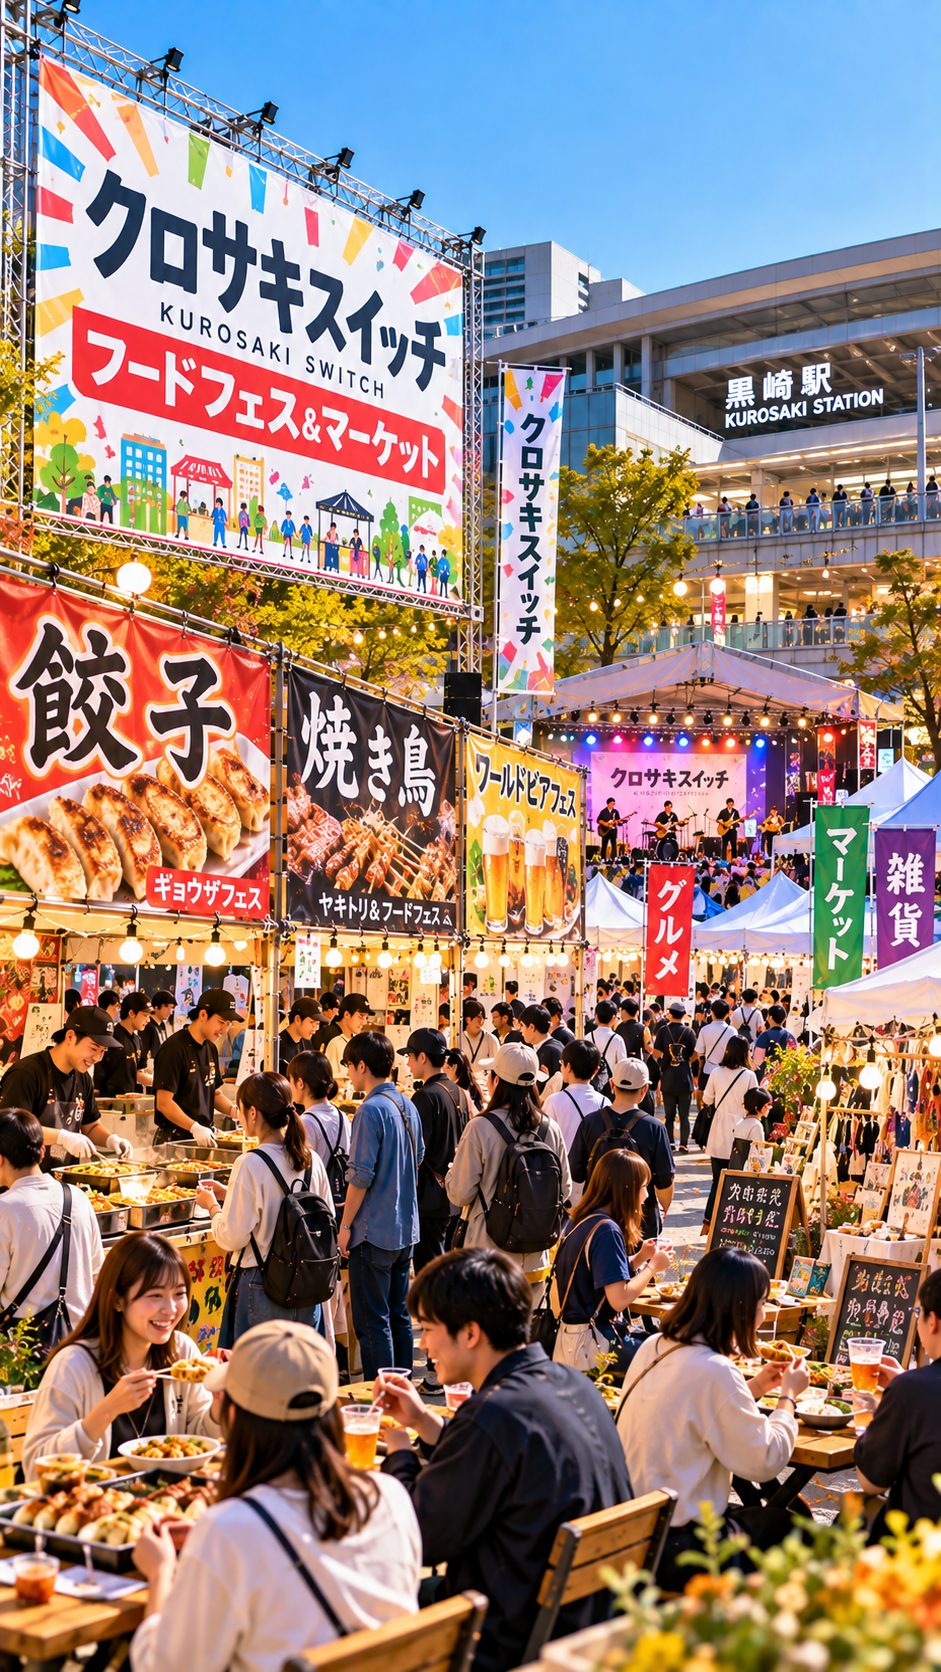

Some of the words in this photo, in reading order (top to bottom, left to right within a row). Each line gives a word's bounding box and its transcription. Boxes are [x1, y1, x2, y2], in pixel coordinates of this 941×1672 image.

[86, 169, 446, 392] クロサキスイッチ
[160, 302, 291, 366] KUROSAKI
[305, 355, 385, 399] SWITCH
[725, 362, 832, 409] 黒崎駅
[87, 329, 439, 478] フードフェス&マーケット
[725, 401, 807, 428] KUROSAKI
[813, 388, 884, 414] STATION
[516, 413, 546, 645] クロサキスイッチ
[15, 621, 232, 784] 餃子
[301, 691, 437, 818] 焼き鳥
[474, 753, 578, 820] ワールドビアフェス
[610, 767, 729, 789] クロサキスイッチ
[154, 872, 262, 911] ギョウザフェス
[318, 892, 441, 926] ヤキトリ&フードフェス
[654, 879, 688, 980] グルメ
[824, 827, 858, 970] マーケット
[886, 852, 926, 948] 雑貨
